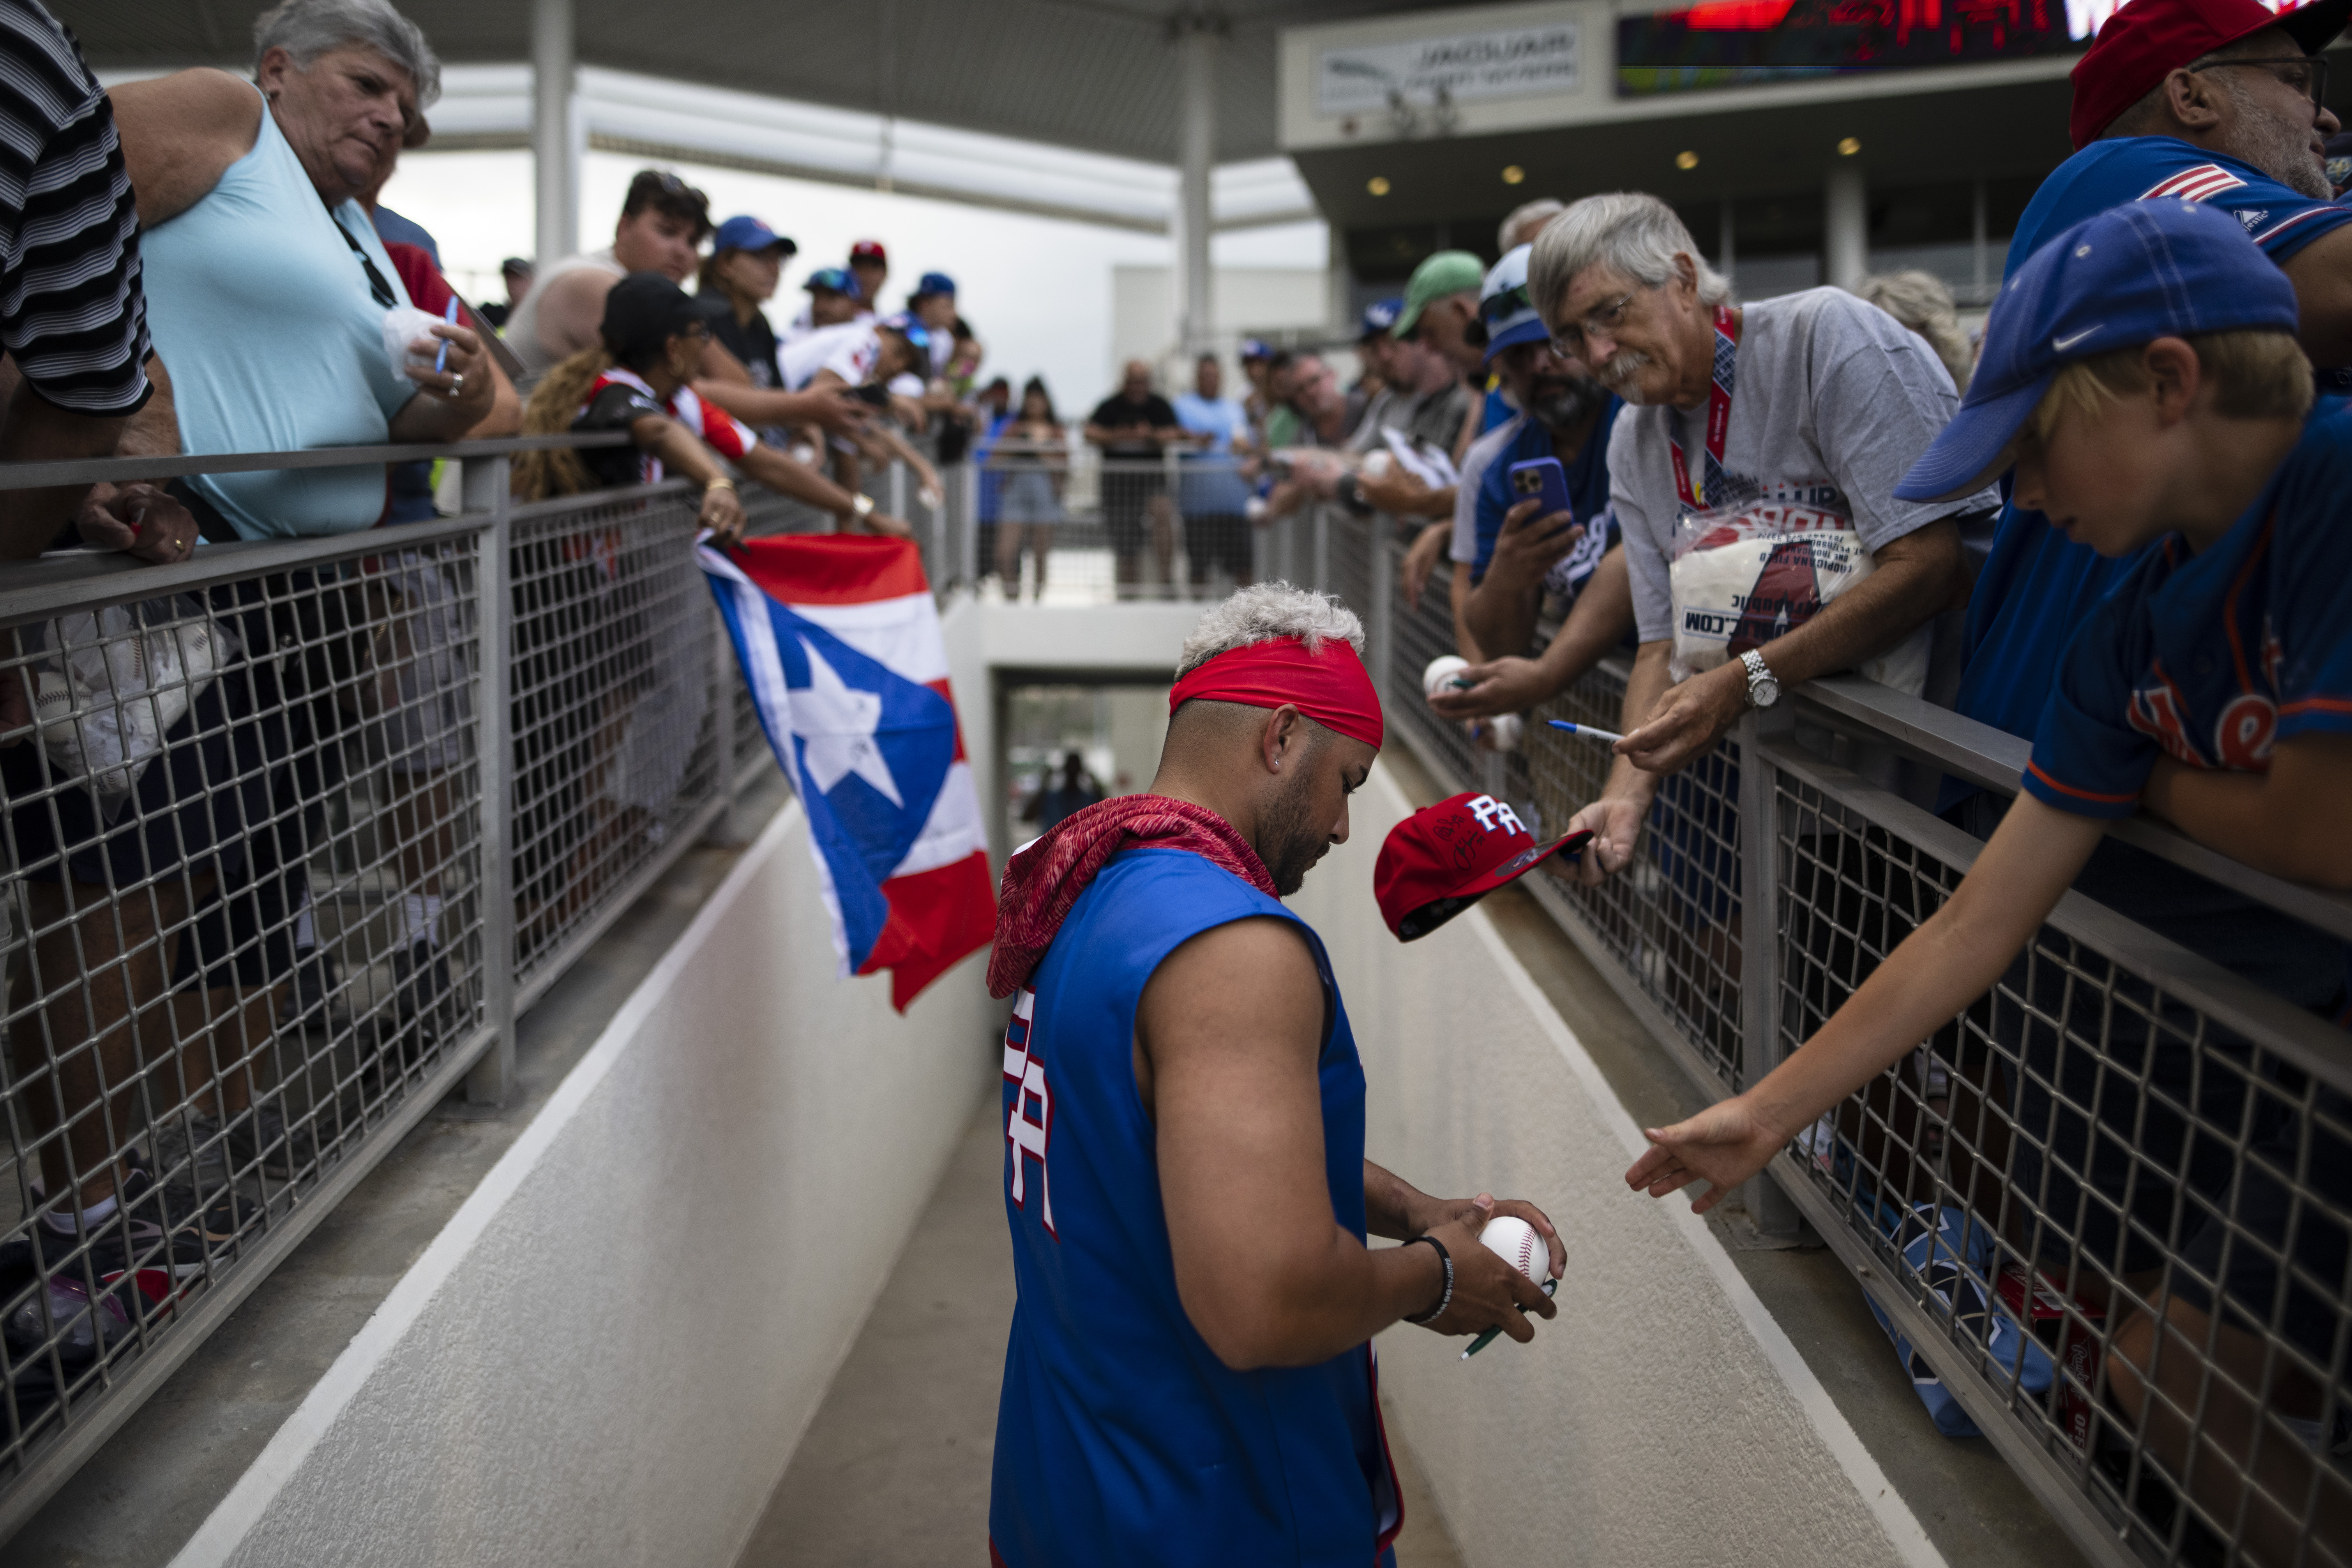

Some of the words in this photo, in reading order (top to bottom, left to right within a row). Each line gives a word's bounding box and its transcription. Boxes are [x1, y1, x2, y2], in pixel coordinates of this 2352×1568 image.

[2244, 212, 2267, 232] jestic
[1785, 545, 1831, 559] TROPICANA
[1834, 554, 1848, 563] ONE
